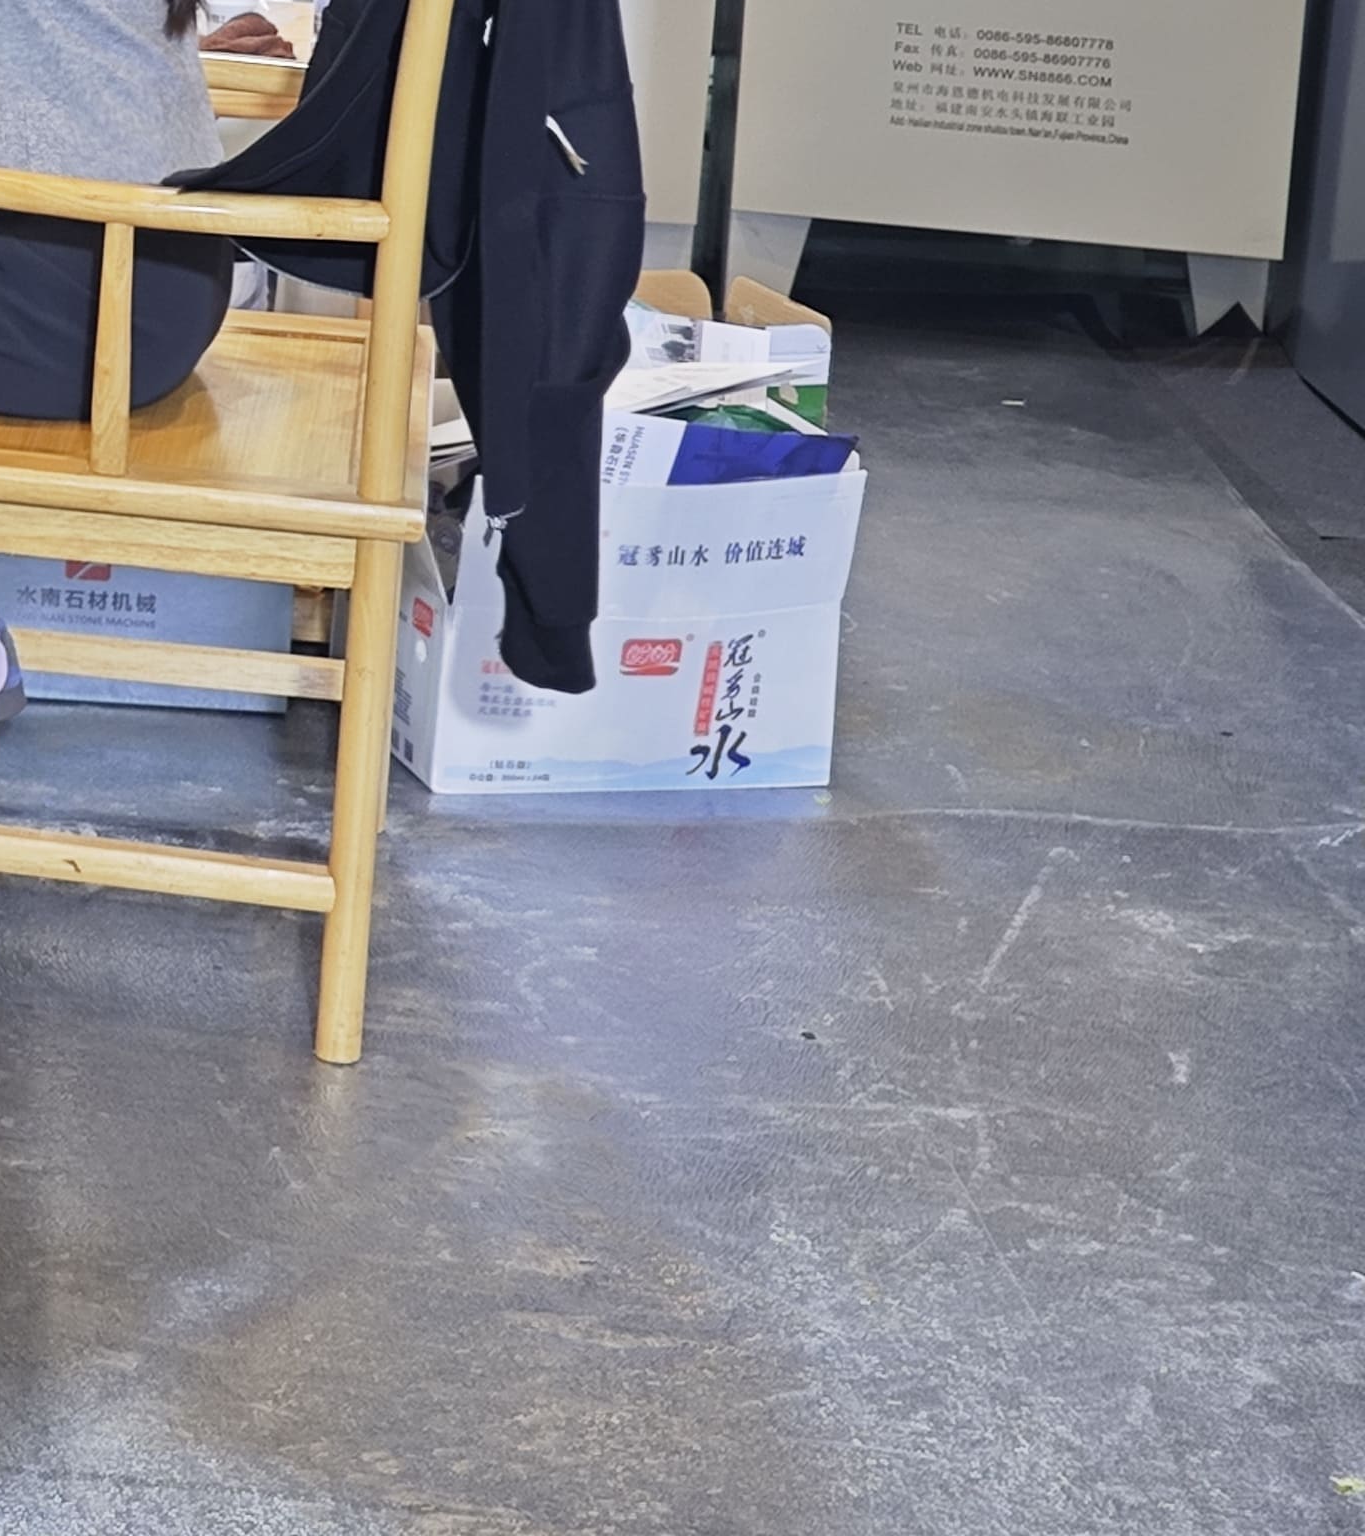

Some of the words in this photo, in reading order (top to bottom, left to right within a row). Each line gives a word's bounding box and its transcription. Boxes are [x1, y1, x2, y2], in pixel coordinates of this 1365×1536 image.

[896, 22, 923, 36] TEL
[894, 41, 920, 54] Fax
[892, 59, 923, 73] Web
[725, 536, 806, 565] 价值连城
[17, 586, 157, 614] 水南石材机械
[67, 614, 103, 626] STONE
[105, 617, 156, 630] MACHINE
